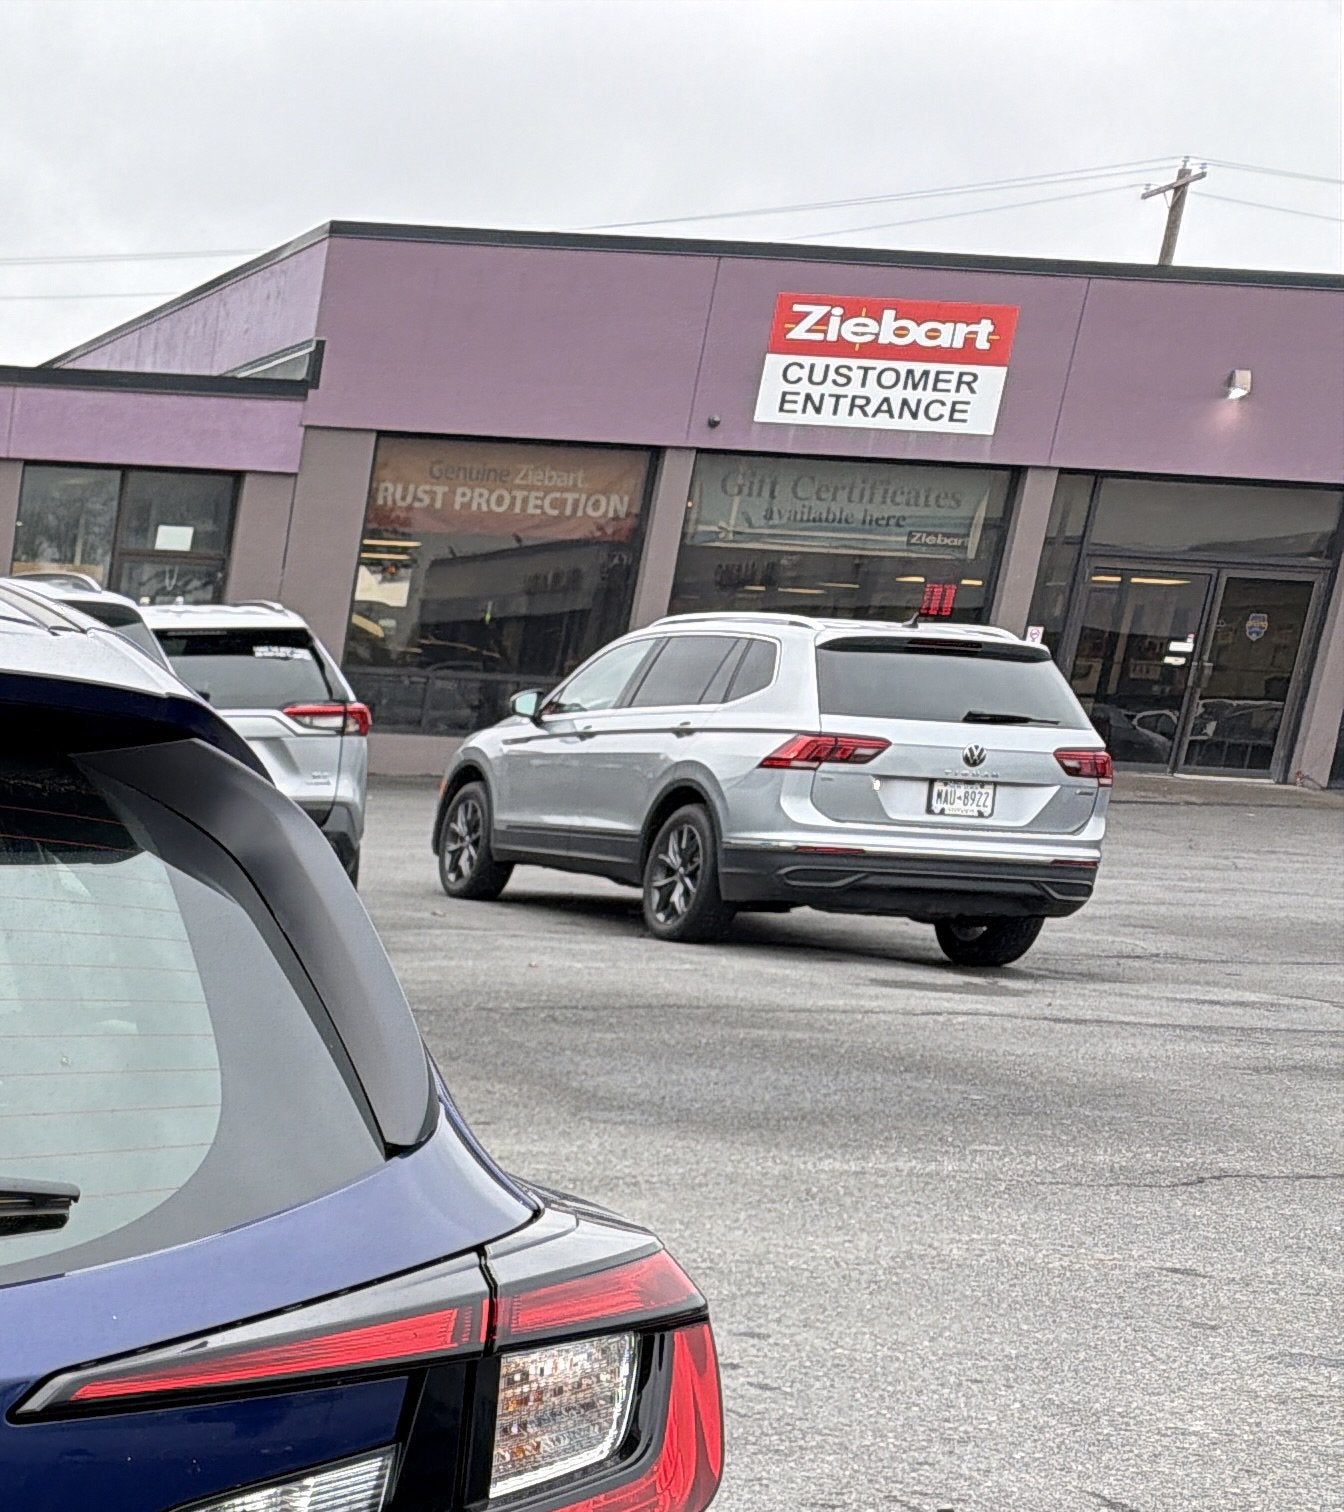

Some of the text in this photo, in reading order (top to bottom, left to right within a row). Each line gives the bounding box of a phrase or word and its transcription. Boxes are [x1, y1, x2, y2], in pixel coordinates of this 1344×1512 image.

[785, 303, 995, 350] Ziebart
[781, 361, 979, 394] CUSTOMER
[778, 391, 971, 423] ENTRANCE
[428, 459, 586, 488] Genuine Ziebart
[376, 482, 629, 519] RUST PROTECTION
[791, 476, 963, 511] Certificates
[762, 504, 907, 529] available here
